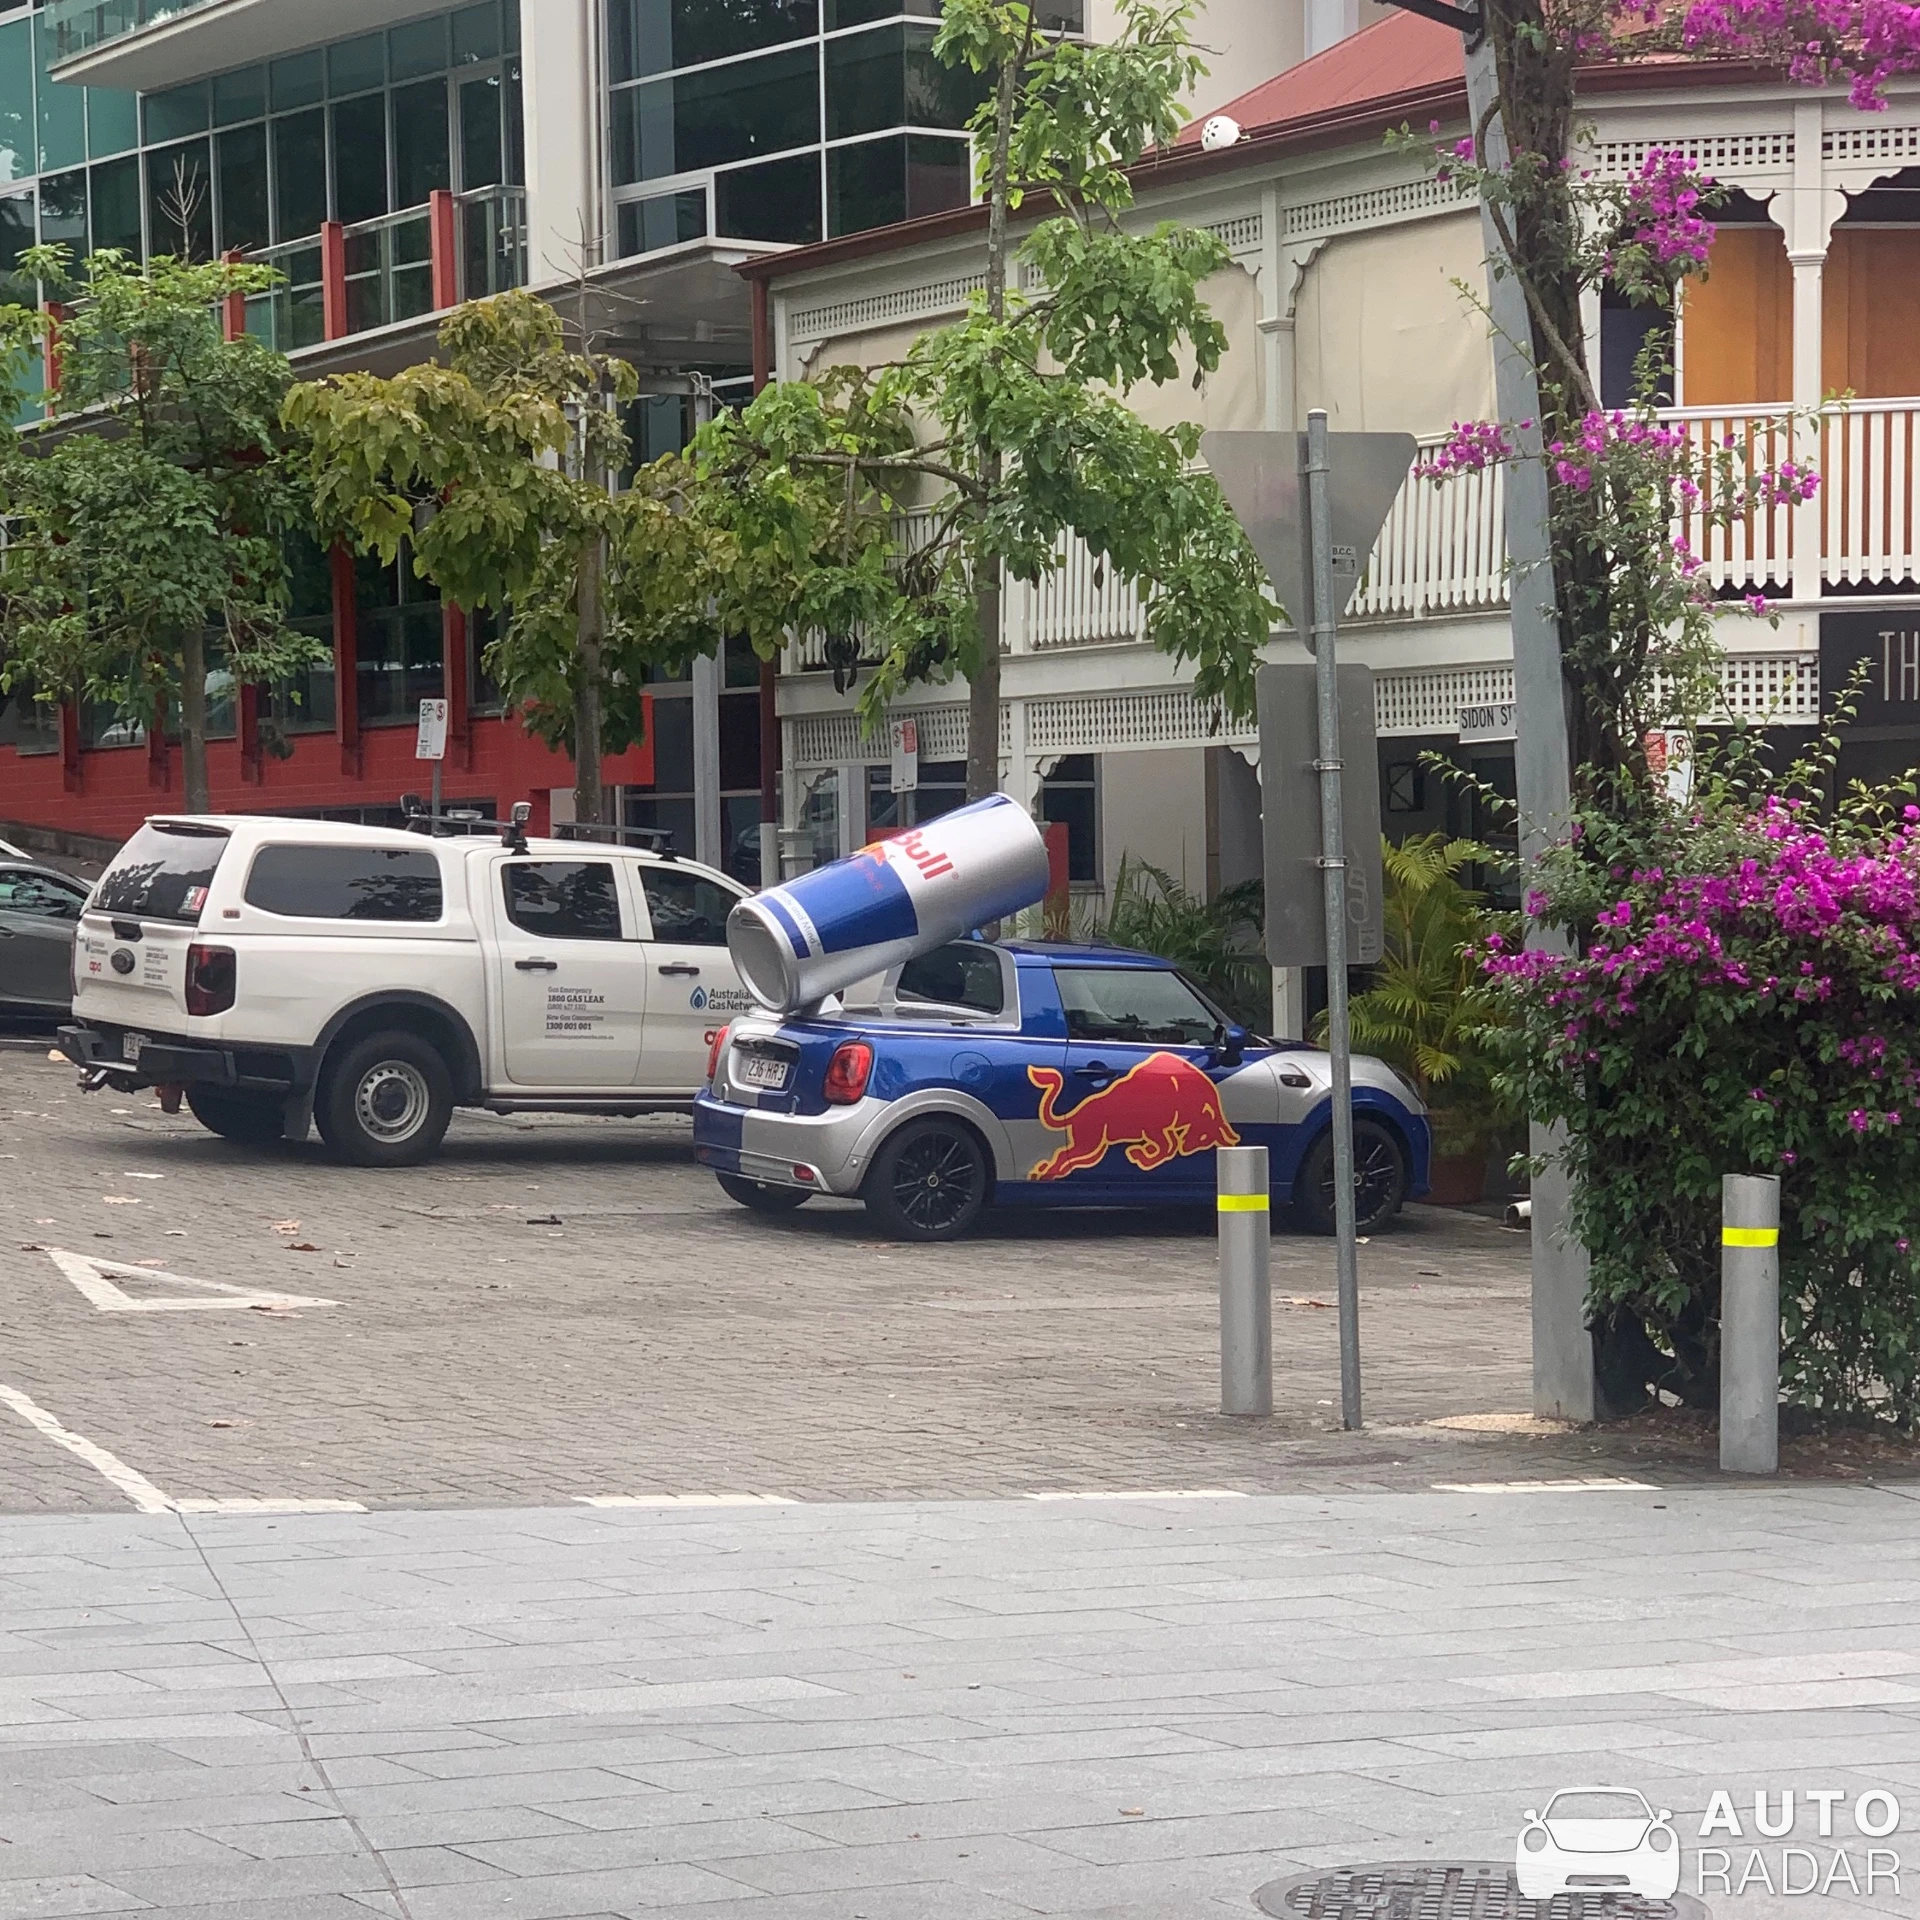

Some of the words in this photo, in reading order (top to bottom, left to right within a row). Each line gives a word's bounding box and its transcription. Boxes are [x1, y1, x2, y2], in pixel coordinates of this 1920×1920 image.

[1461, 706, 1494, 729] SIDON
[1500, 704, 1512, 726] ST
[567, 995, 582, 1003] GAS
[709, 999, 725, 1010] Gas
[546, 1022, 563, 1030] 1300
